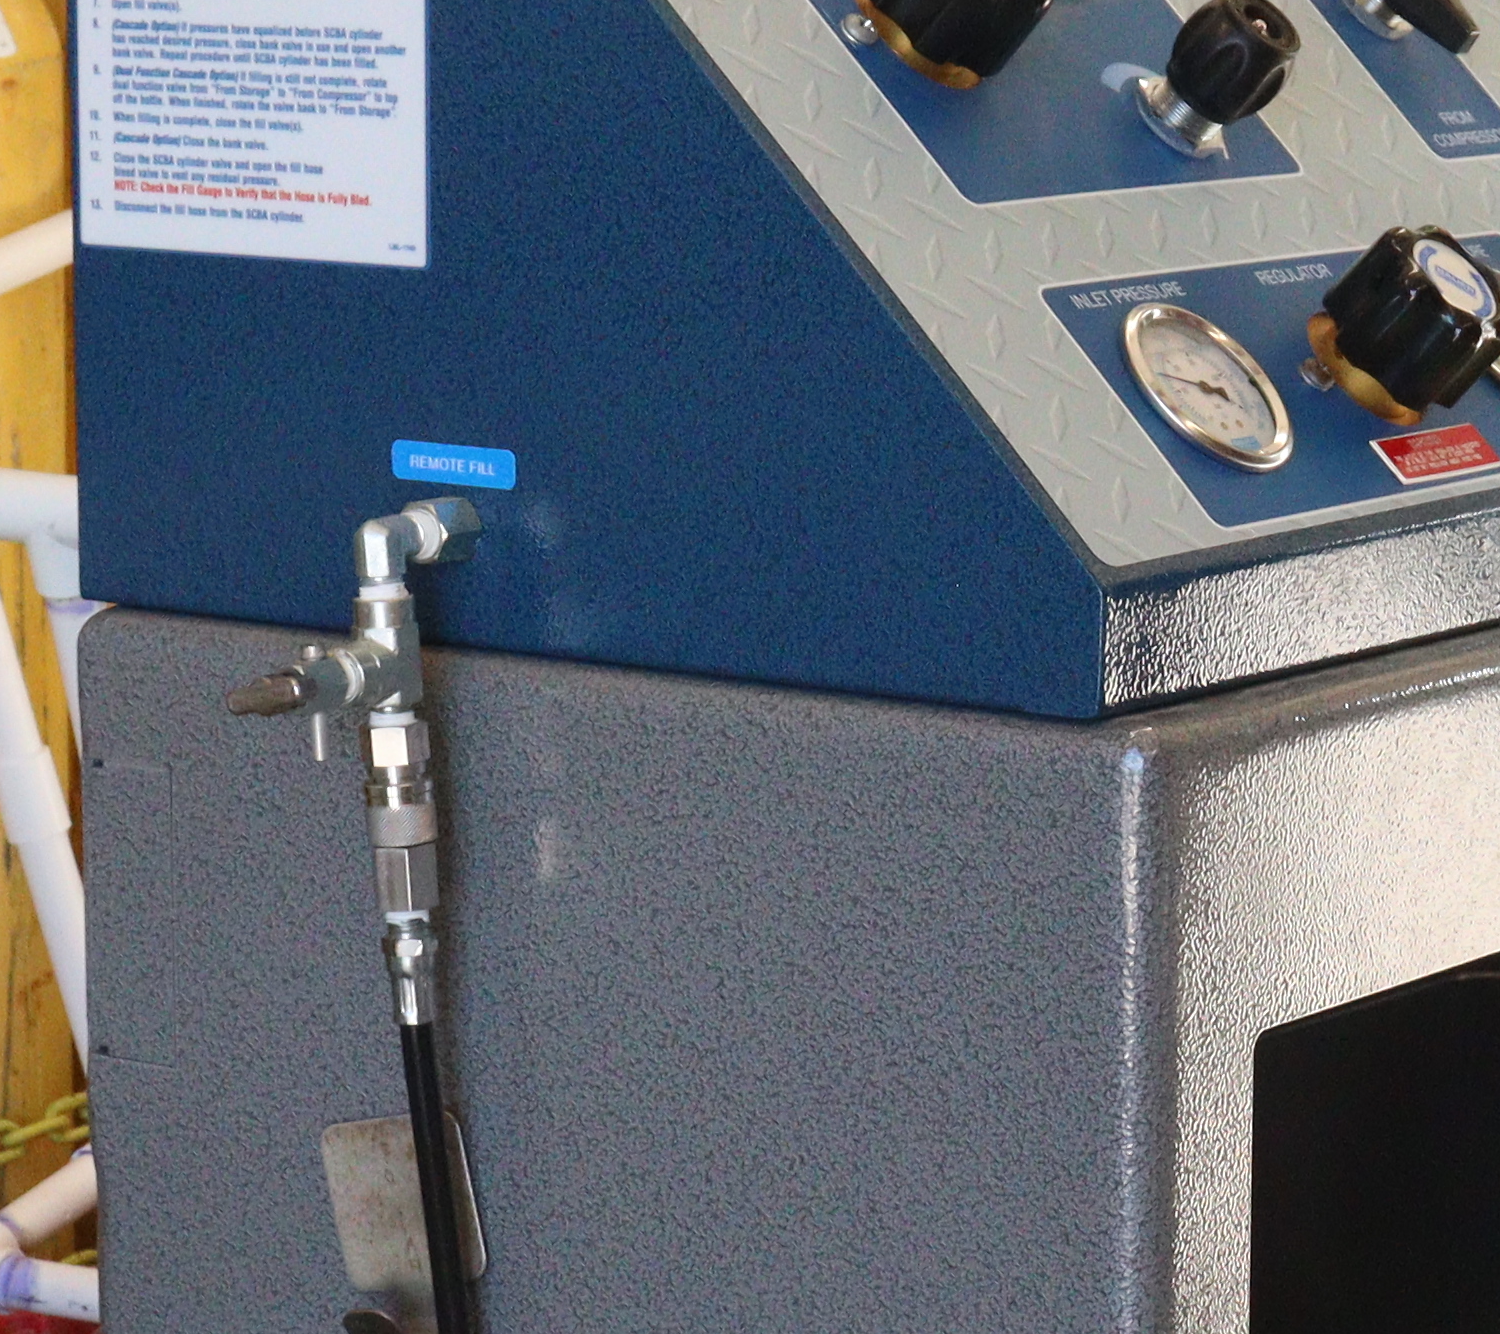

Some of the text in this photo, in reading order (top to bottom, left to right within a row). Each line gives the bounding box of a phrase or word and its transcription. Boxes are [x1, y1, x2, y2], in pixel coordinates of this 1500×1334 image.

[1438, 110, 1476, 126] FROM
[1253, 263, 1333, 287] REGULATOR
[1070, 280, 1188, 310] INLET PRESSURE
[408, 453, 495, 476] REMOTE FILL
